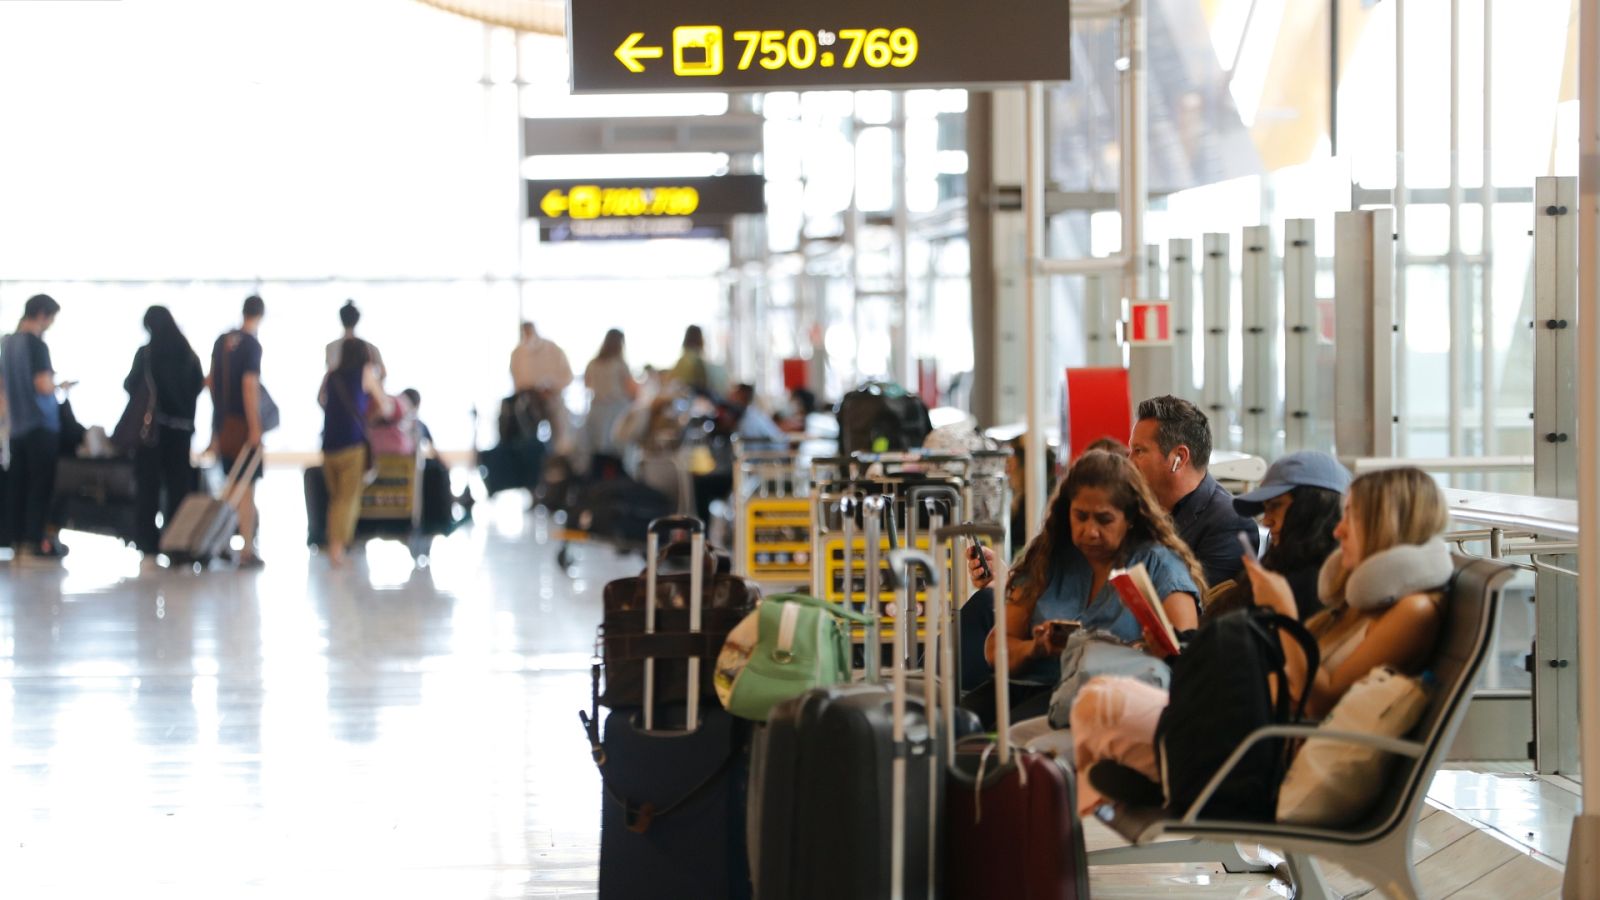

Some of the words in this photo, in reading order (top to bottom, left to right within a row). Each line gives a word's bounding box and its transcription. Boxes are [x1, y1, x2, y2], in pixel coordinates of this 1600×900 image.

[734, 29, 817, 70] 750
[817, 29, 836, 46] to
[839, 27, 918, 68] 769
